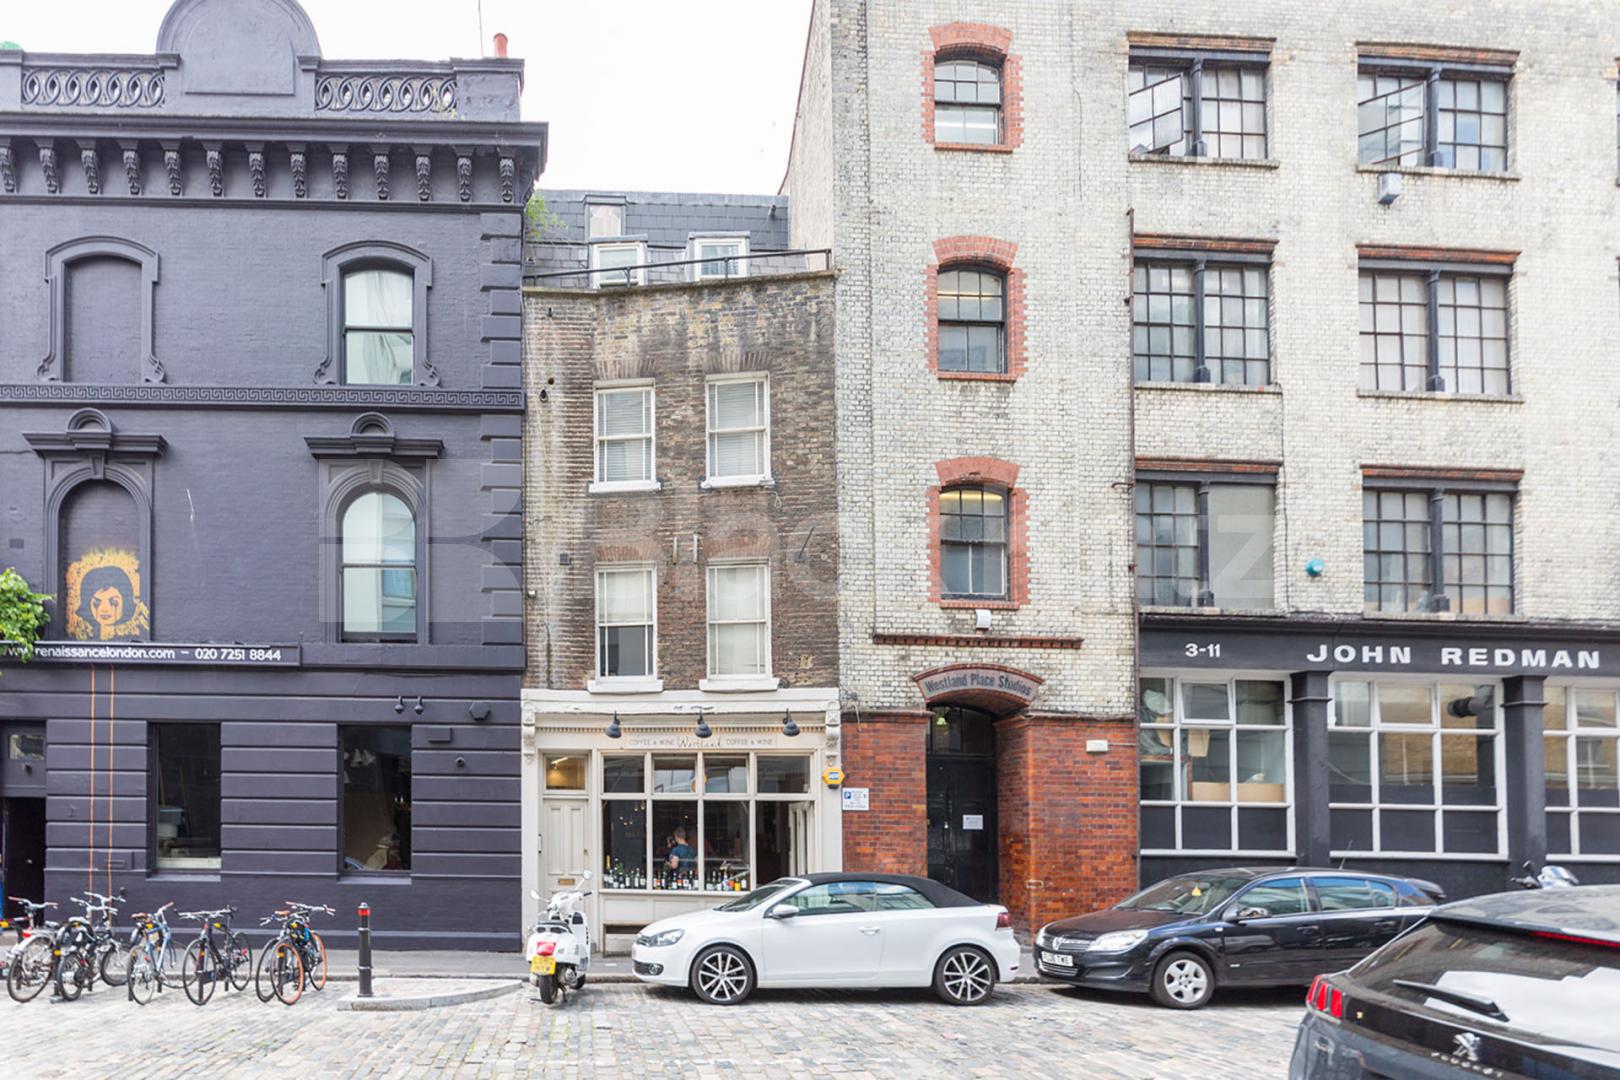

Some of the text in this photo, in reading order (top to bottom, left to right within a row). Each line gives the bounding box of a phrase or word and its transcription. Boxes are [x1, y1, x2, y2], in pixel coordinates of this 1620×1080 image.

[195, 648, 217, 660] 020
[220, 648, 245, 661] 7251
[249, 649, 281, 661] 8844
[1185, 643, 1221, 658] 3-11
[1306, 644, 1600, 669] JOHN REDMAN
[924, 673, 1032, 696] Westland Place Studios
[629, 738, 650, 746] COFFEE
[726, 738, 748, 746] COFFEE
